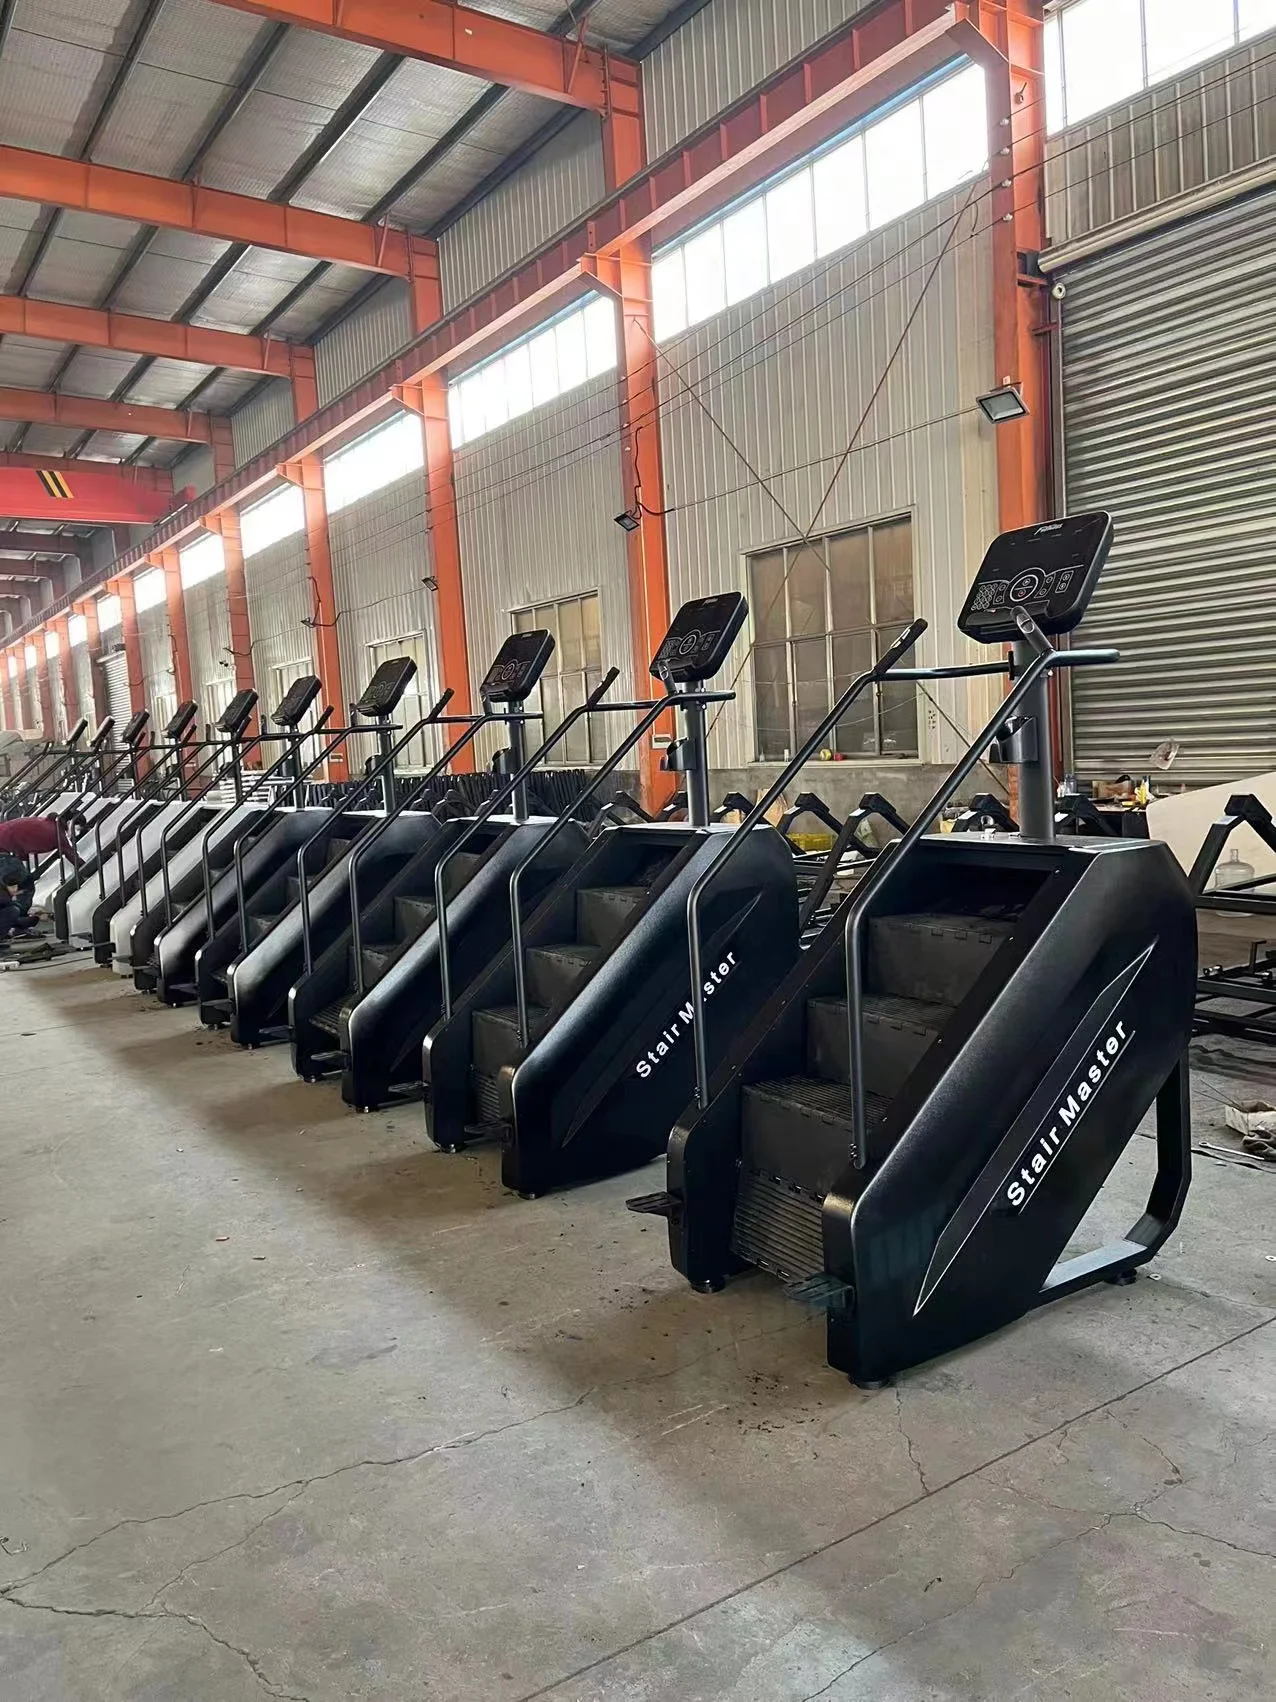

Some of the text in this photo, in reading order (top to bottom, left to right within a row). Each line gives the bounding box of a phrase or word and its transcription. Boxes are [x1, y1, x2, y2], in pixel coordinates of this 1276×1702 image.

[636, 951, 736, 1078] Stair Mster
[1007, 1020, 1127, 1206] Stair Master
